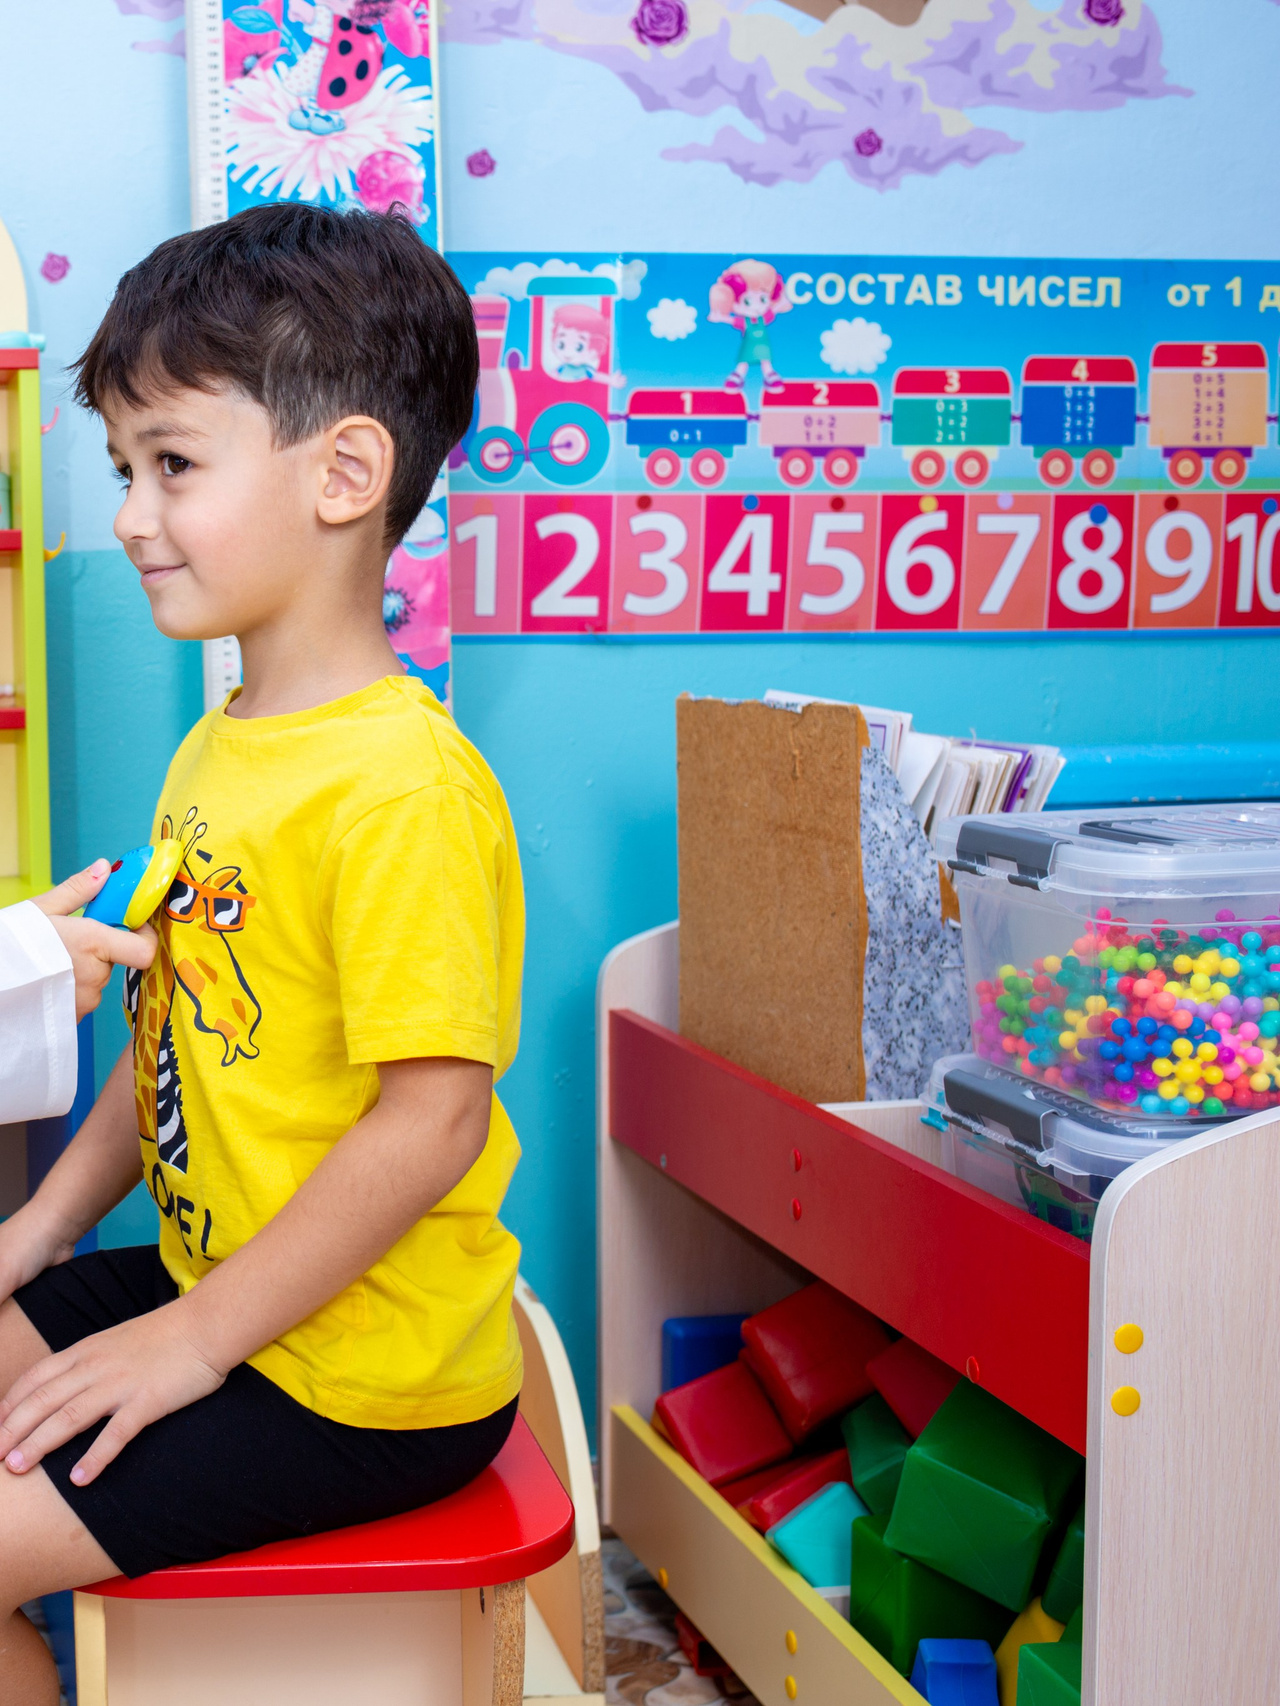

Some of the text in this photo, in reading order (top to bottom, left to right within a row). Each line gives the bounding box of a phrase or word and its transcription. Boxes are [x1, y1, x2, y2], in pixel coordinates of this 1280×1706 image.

[785, 272, 963, 306] СОСТАВ
[977, 275, 1122, 308] ЧИСЕЛ
[1167, 283, 1211, 307] от
[1225, 276, 1242, 307] 1
[1201, 344, 1218, 368] 5
[944, 369, 961, 393] 3
[1071, 358, 1090, 382] 4
[680, 391, 693, 415] 1
[812, 382, 830, 406] 2
[454, 514, 498, 617] 1
[530, 512, 600, 618] 2
[622, 511, 688, 616] 3
[708, 513, 781, 616] 4
[799, 512, 865, 616] 5
[885, 510, 955, 616] 6
[977, 513, 1041, 615] 7
[1056, 510, 1125, 614] 8
[1144, 510, 1213, 614] 9
